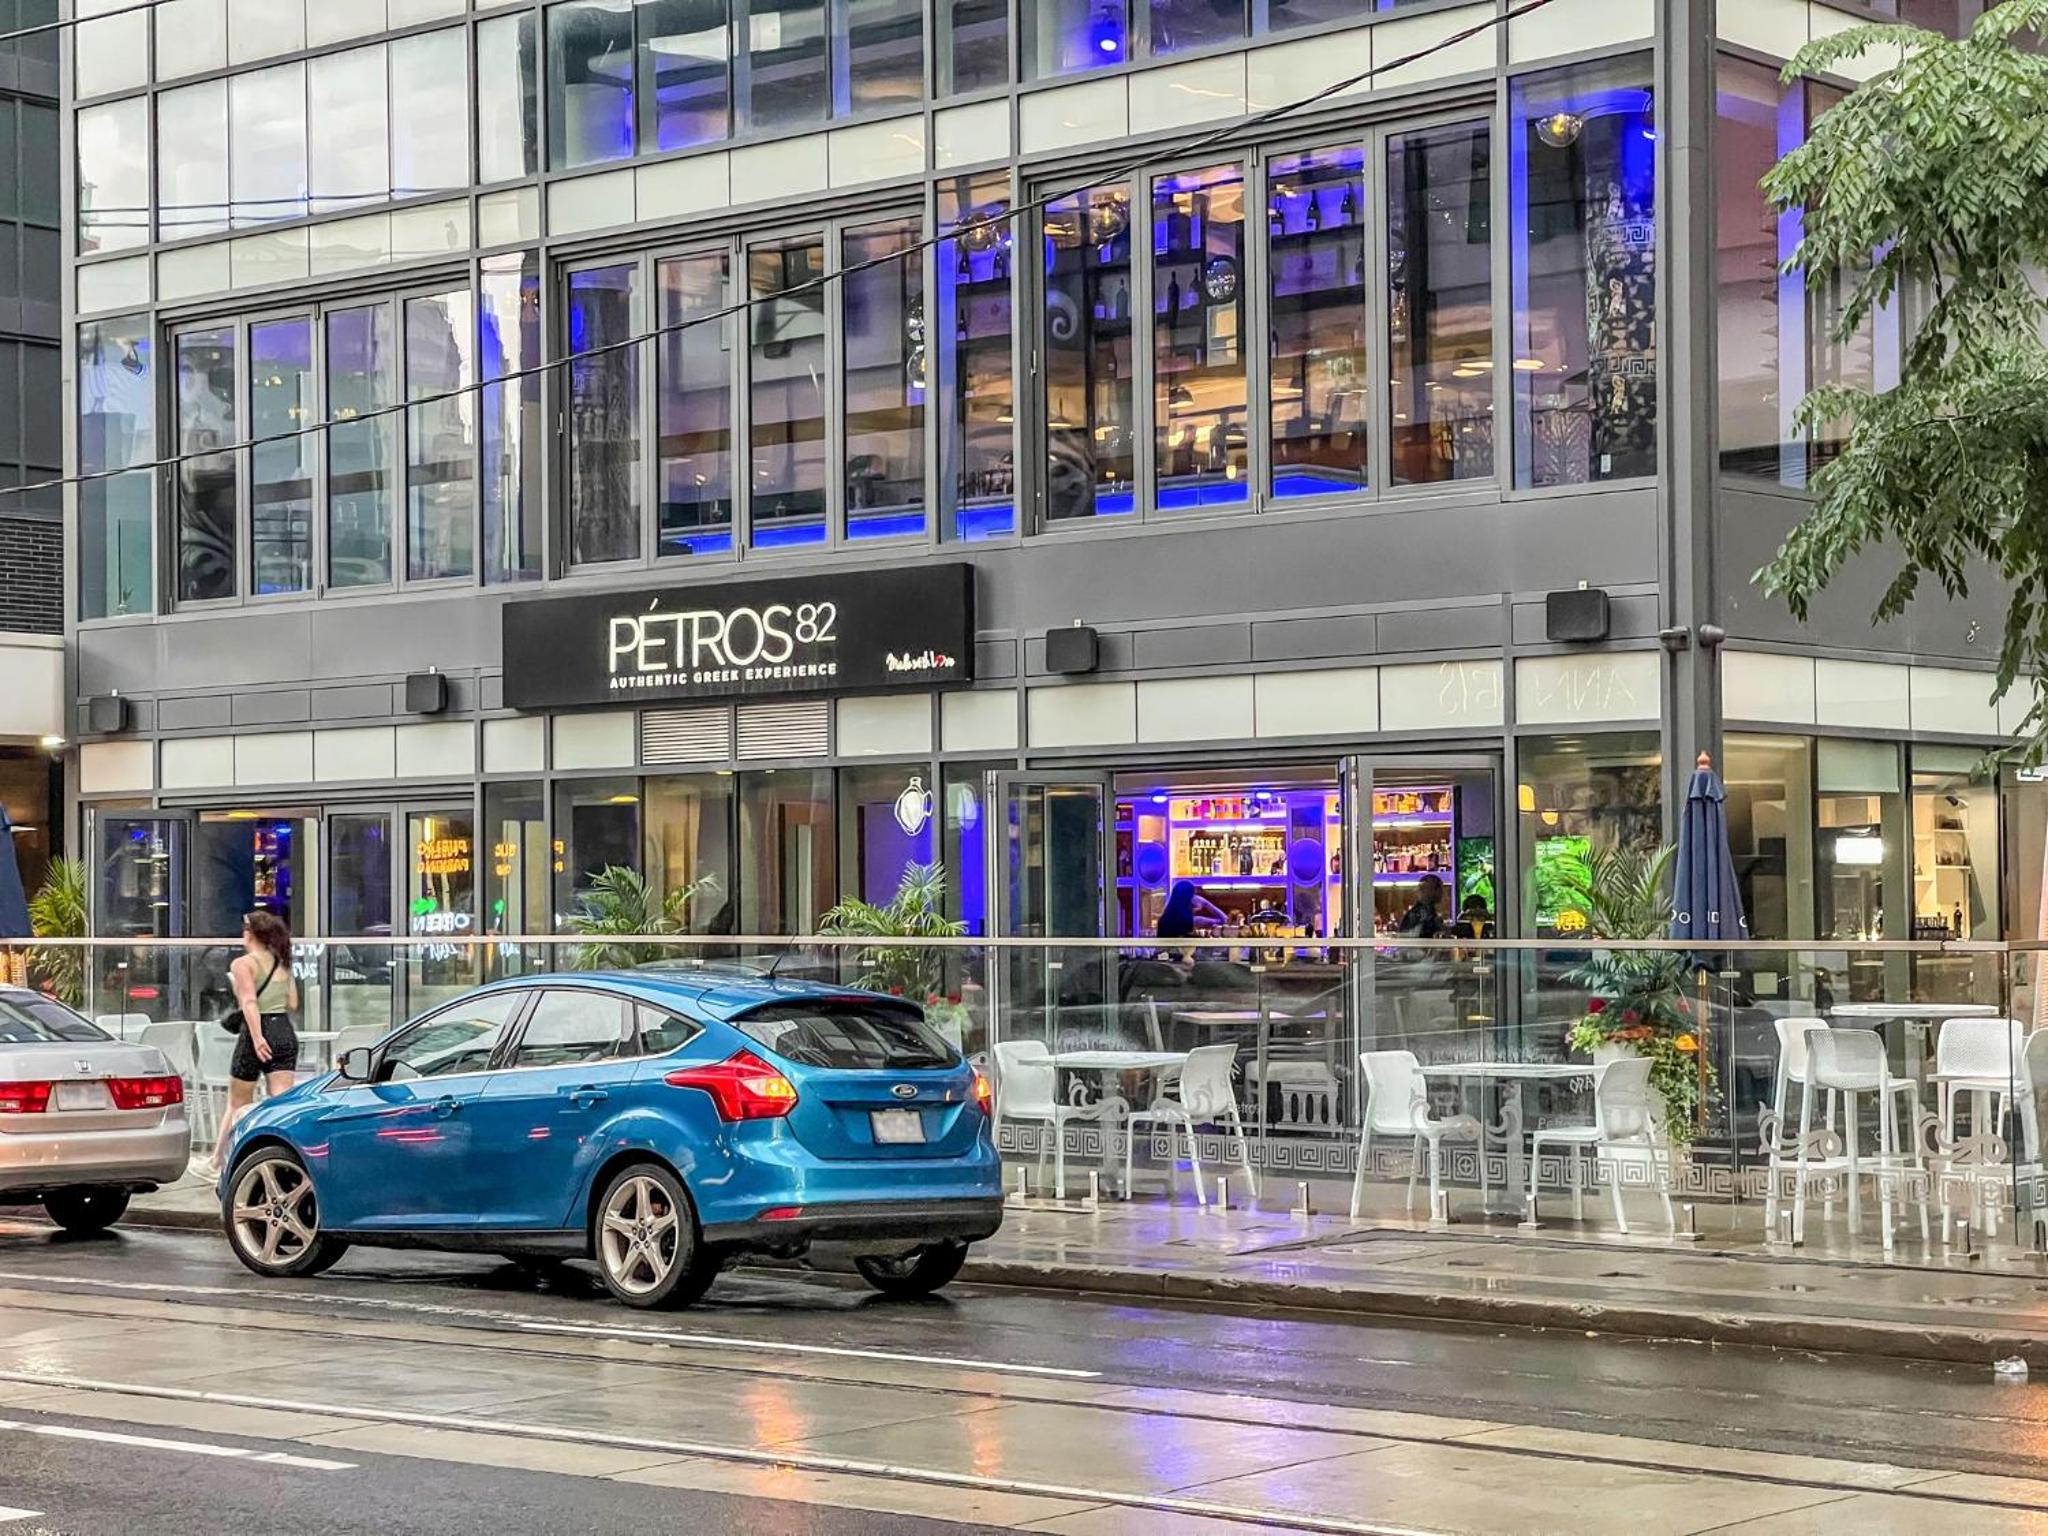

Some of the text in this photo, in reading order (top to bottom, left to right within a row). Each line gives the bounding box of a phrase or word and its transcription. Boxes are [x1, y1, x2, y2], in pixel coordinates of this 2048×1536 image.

[609, 598, 838, 673] PÉTROS 82
[609, 662, 838, 689] AUTHENTIC GREEK EXPERIENCE
